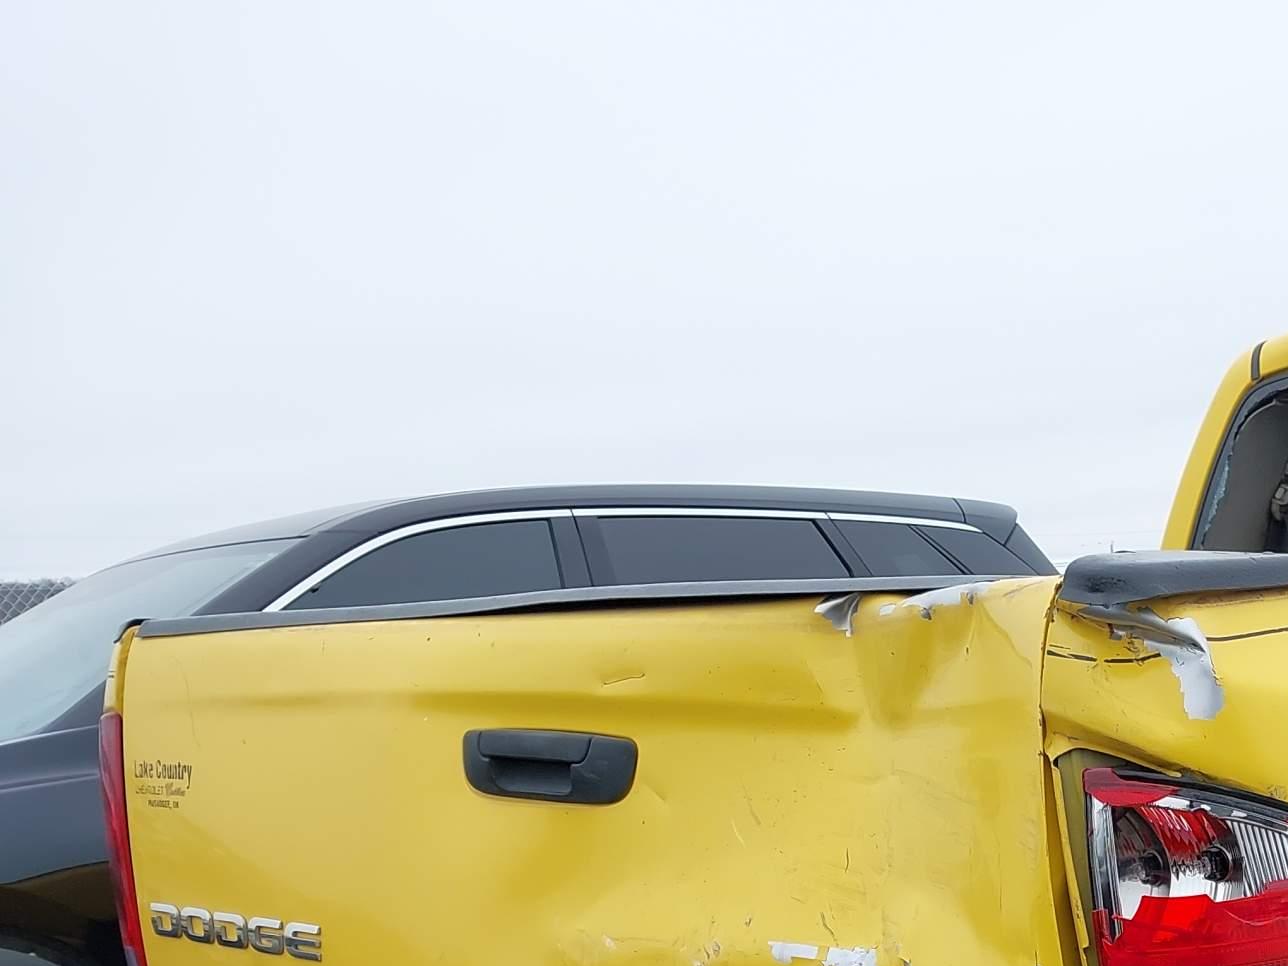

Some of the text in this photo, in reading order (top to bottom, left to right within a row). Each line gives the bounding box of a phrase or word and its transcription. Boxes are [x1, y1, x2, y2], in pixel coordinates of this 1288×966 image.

[134, 759, 192, 789] Lake Country
[150, 902, 322, 961] DODGE
